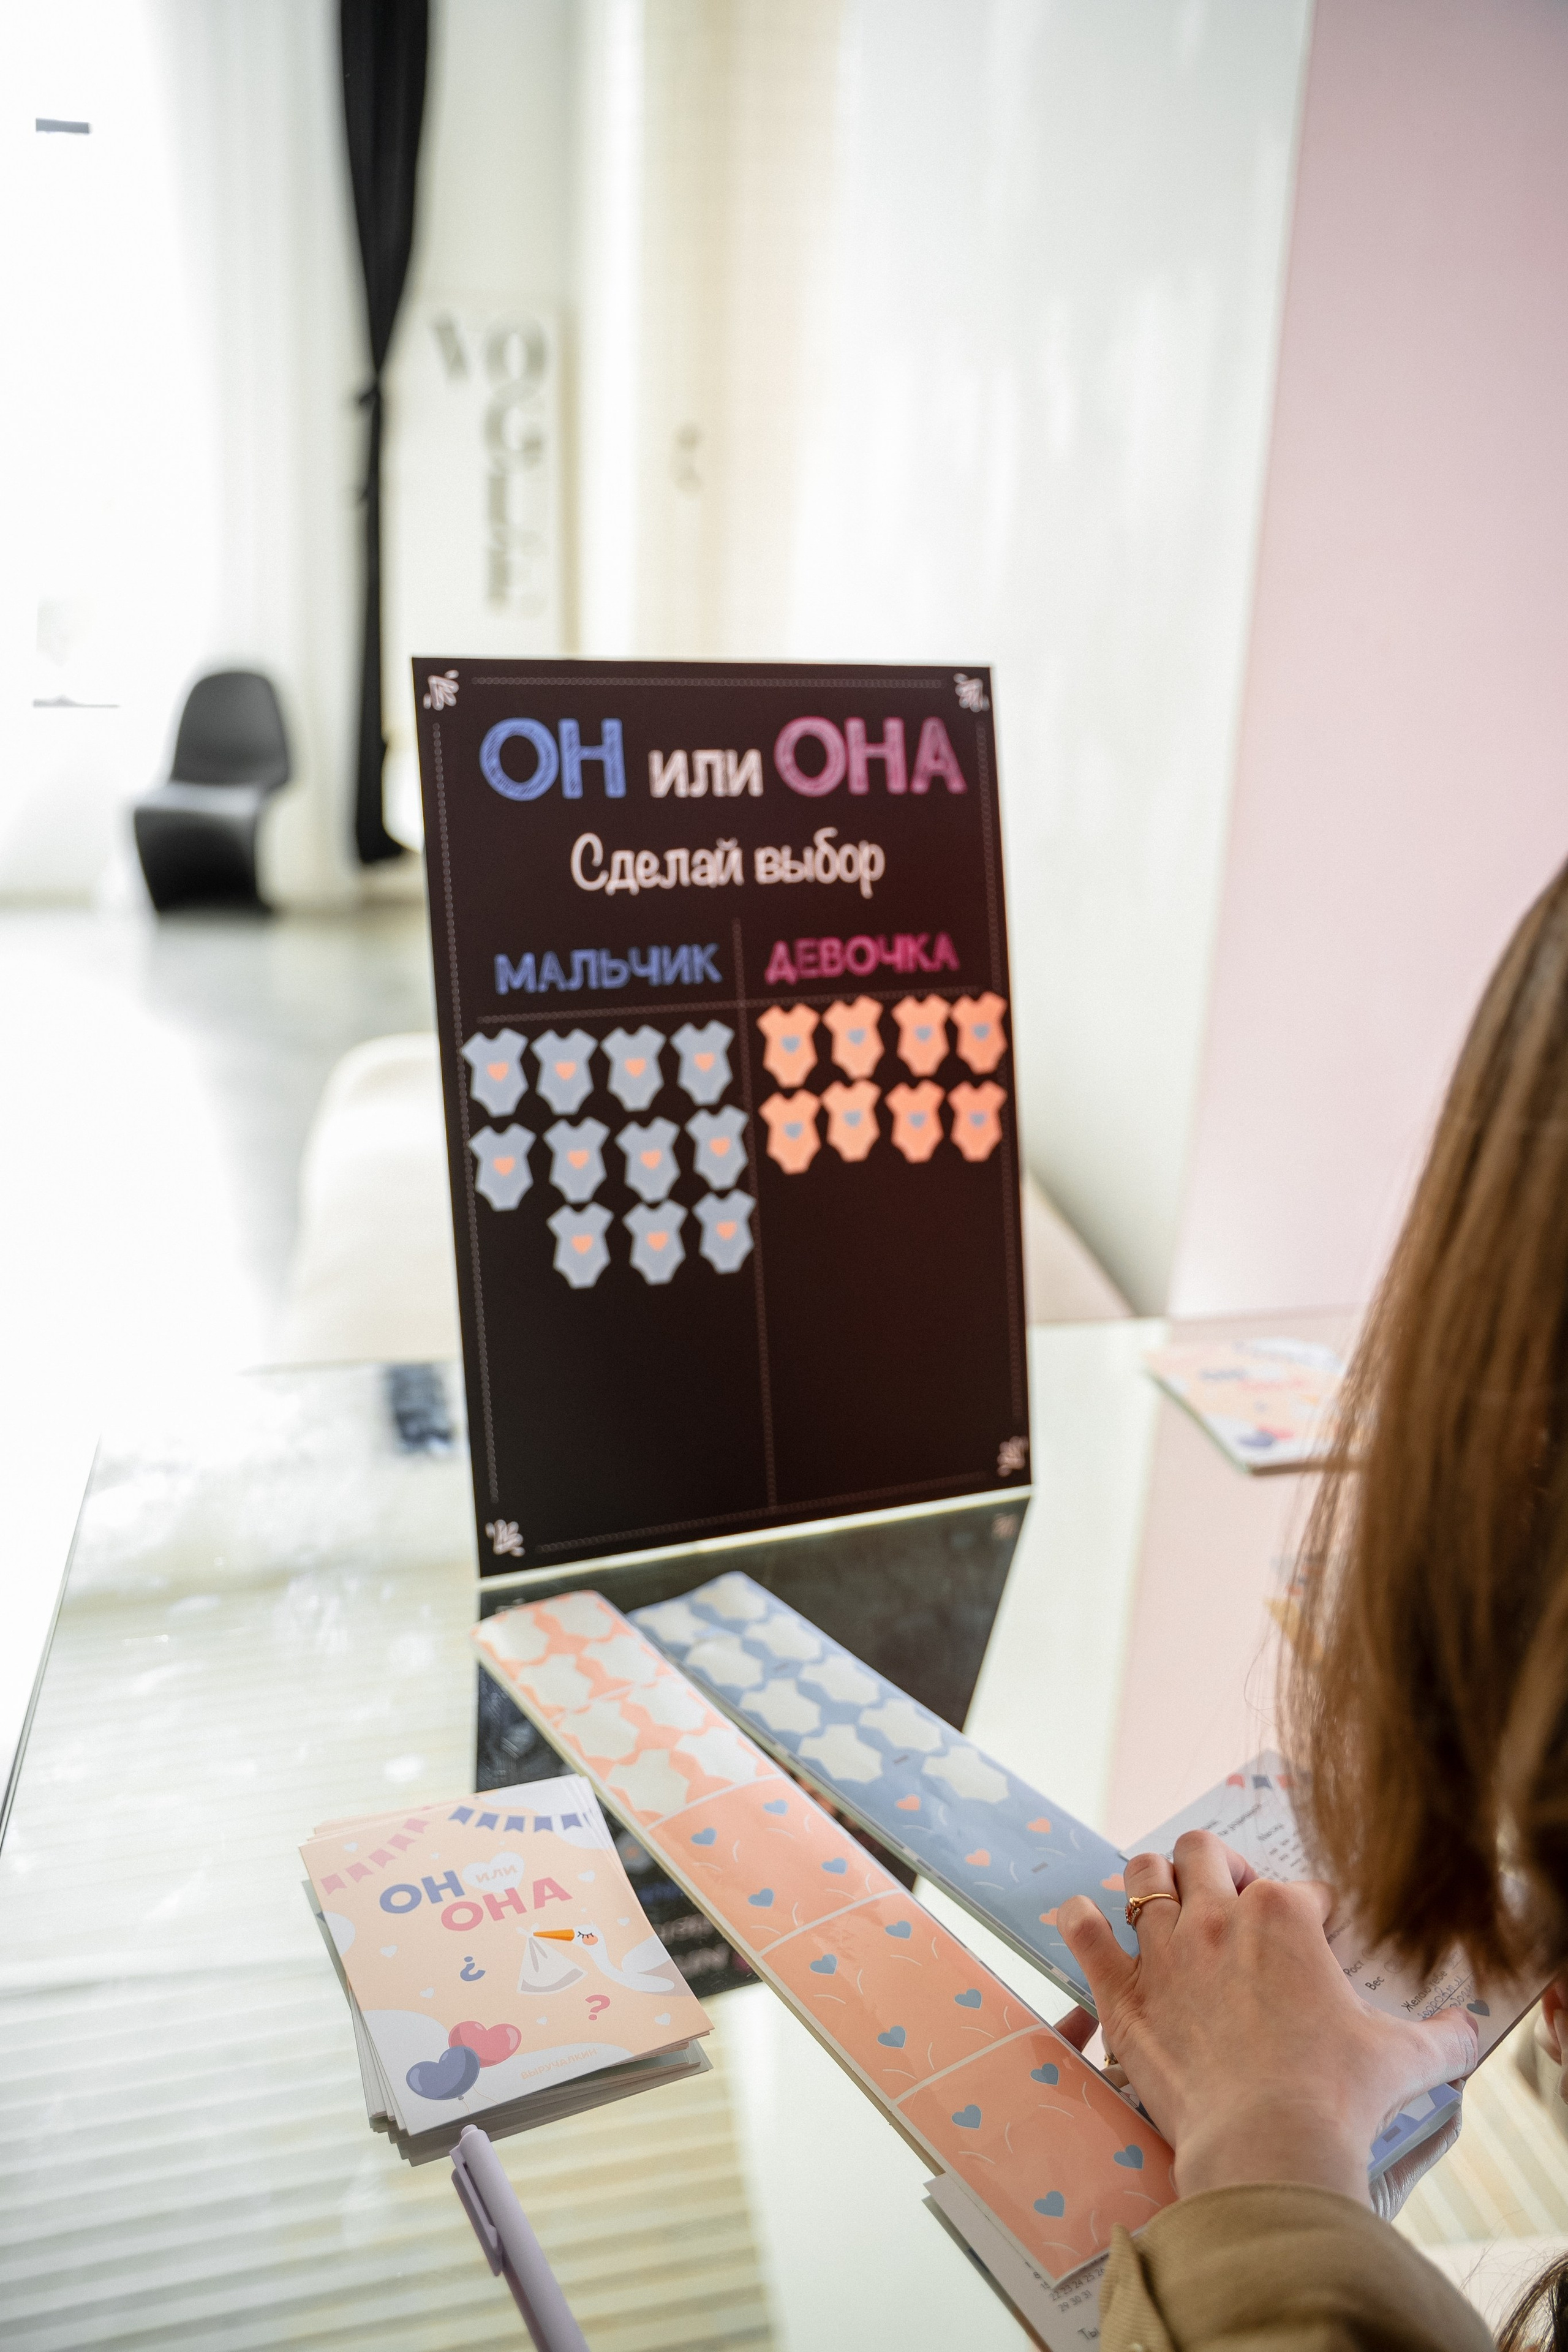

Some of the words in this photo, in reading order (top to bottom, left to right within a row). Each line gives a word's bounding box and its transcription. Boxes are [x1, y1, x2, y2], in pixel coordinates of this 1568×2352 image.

[479, 717, 627, 801] ОН
[649, 749, 763, 798] или
[774, 717, 968, 799] ОНА
[571, 832, 744, 895] Сделай
[755, 826, 886, 899] выбор
[494, 943, 723, 995] МАЛЬЧИК
[764, 932, 961, 987] ДЕВОЧКА
[379, 1870, 465, 1914] ОН
[441, 1877, 573, 1931] ОНА
[1365, 1976, 1385, 1991] Вес
[1401, 1986, 1432, 2013] Желаю
[521, 2048, 598, 2080] ВЫРУЧАЛКИН
[1040, 2281, 1050, 2290] 15
[1049, 2291, 1061, 2301] 22
[1060, 2285, 1072, 2295] 23
[1072, 2278, 1084, 2289] 24
[1084, 2273, 1095, 2282] 25
[1058, 2301, 1069, 2312] 29
[1069, 2295, 1082, 2305] 30
[1081, 2289, 1093, 2299] 31
